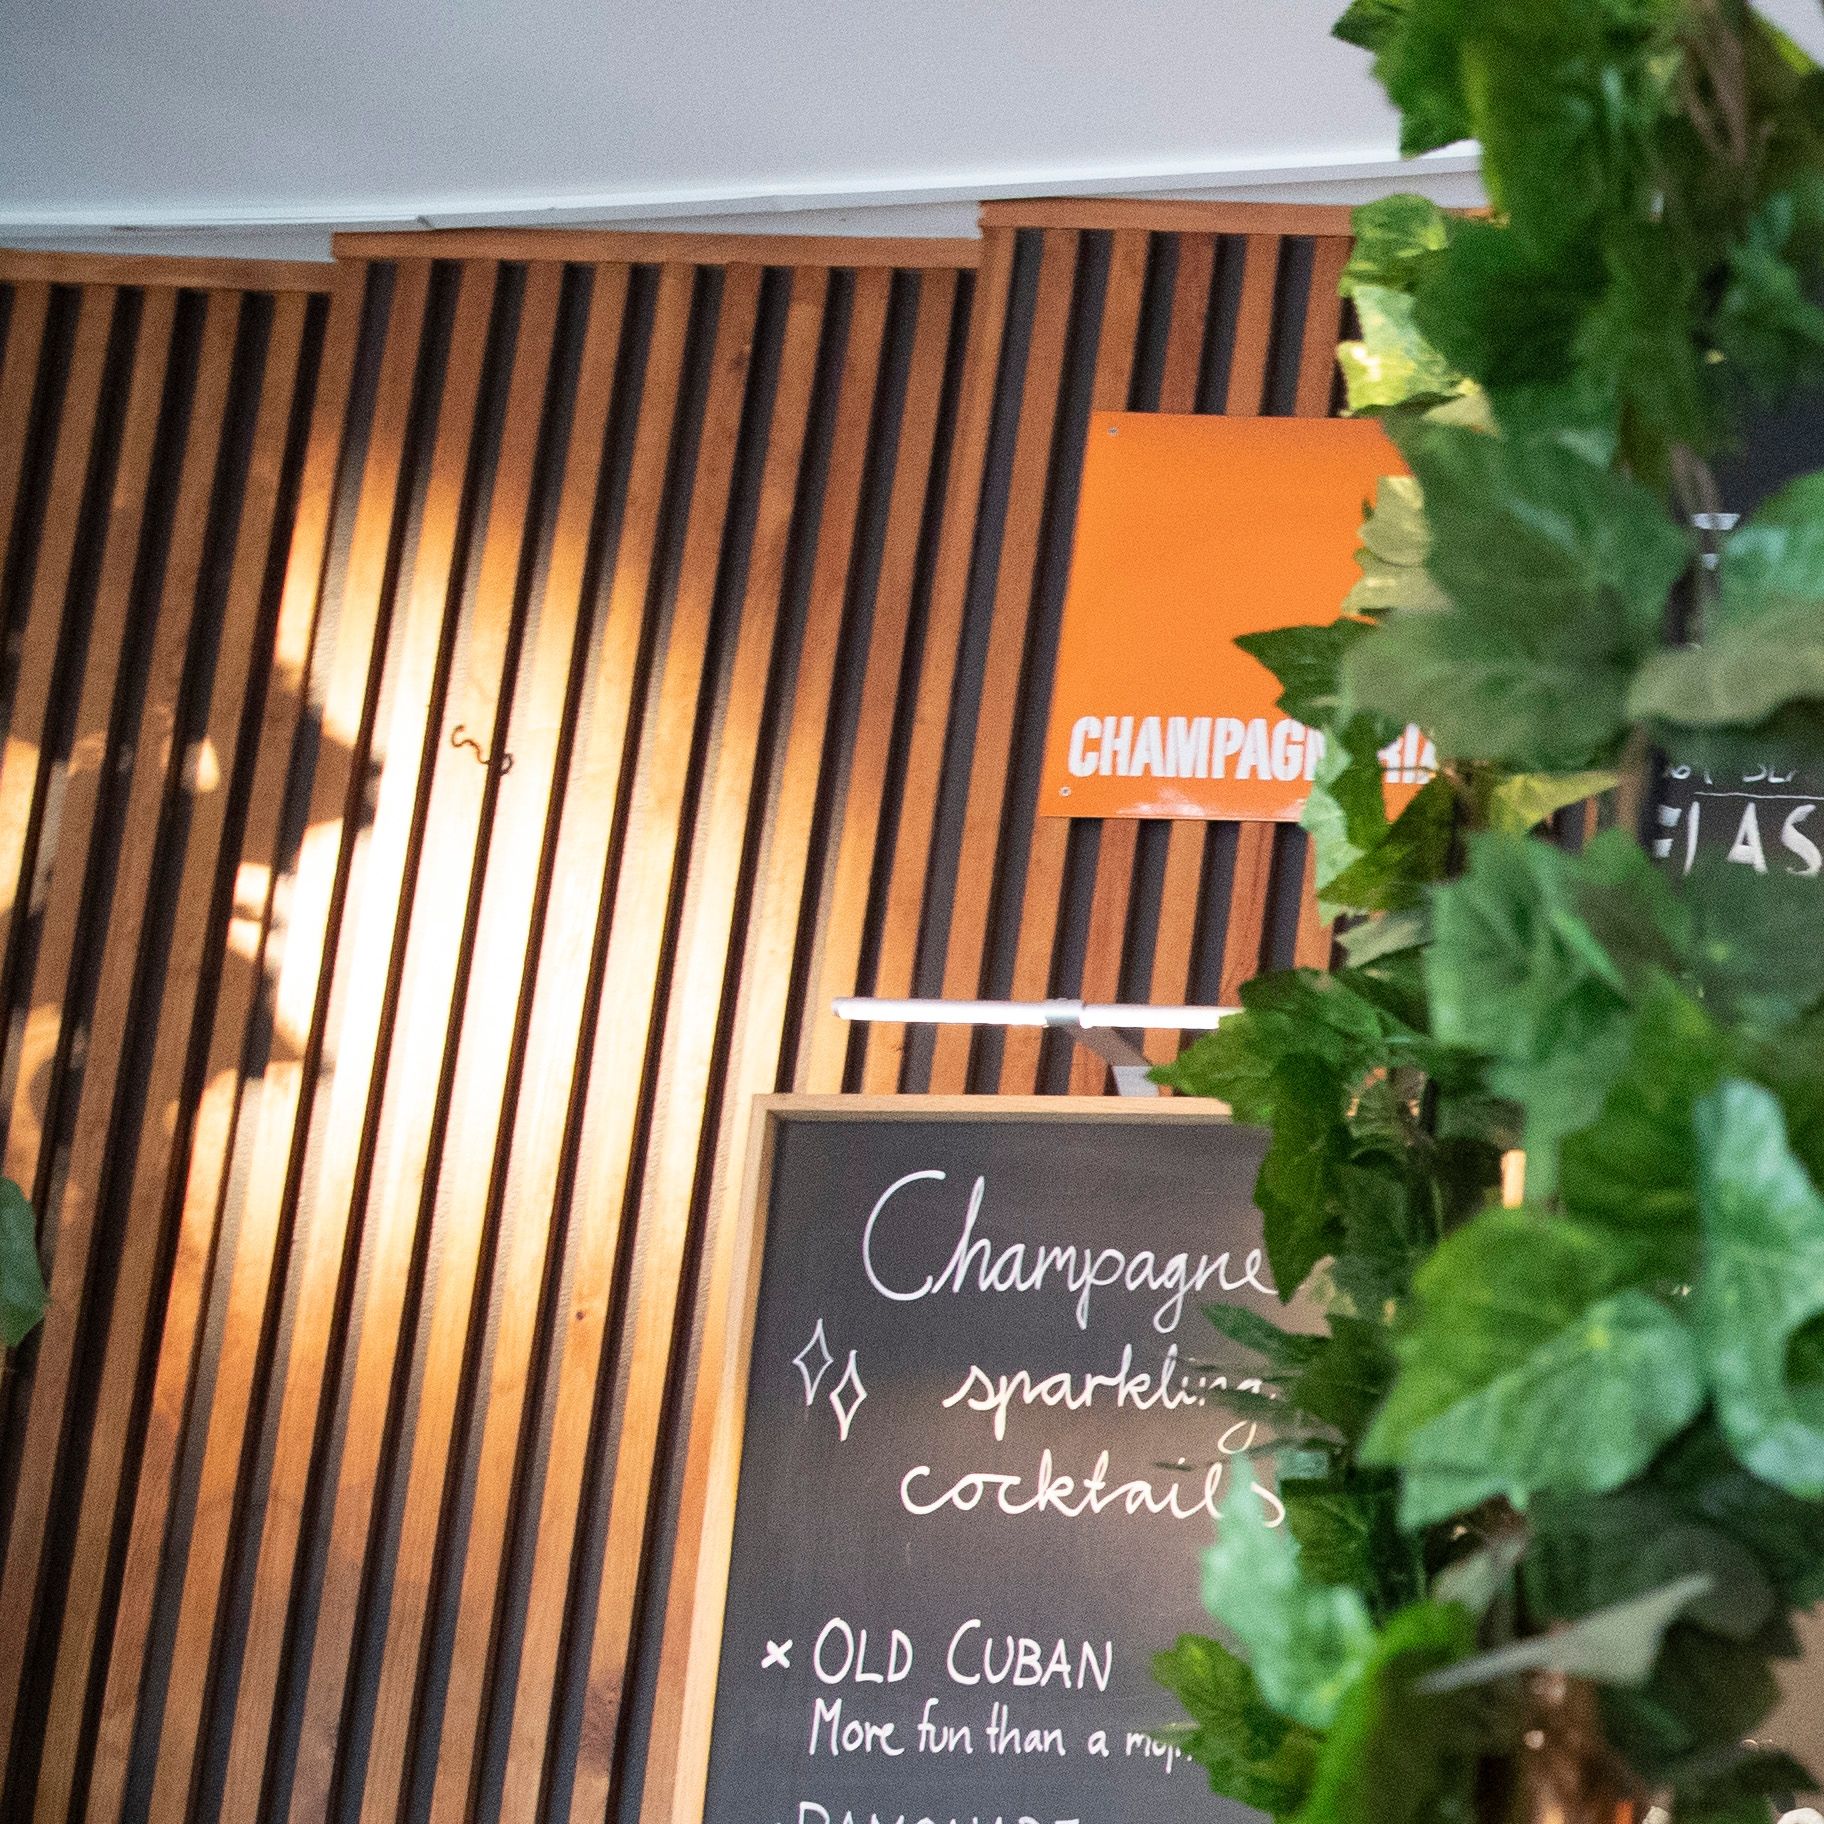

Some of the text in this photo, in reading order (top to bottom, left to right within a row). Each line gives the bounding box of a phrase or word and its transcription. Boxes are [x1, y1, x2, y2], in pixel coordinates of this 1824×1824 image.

[861, 1168, 1277, 1334] Champagne
[812, 1616, 1113, 1692] OLD CUBAN
[808, 1697, 905, 1757] More
[916, 1696, 974, 1755] fun
[984, 1701, 1067, 1757] than
[1086, 1729, 1110, 1758] a
